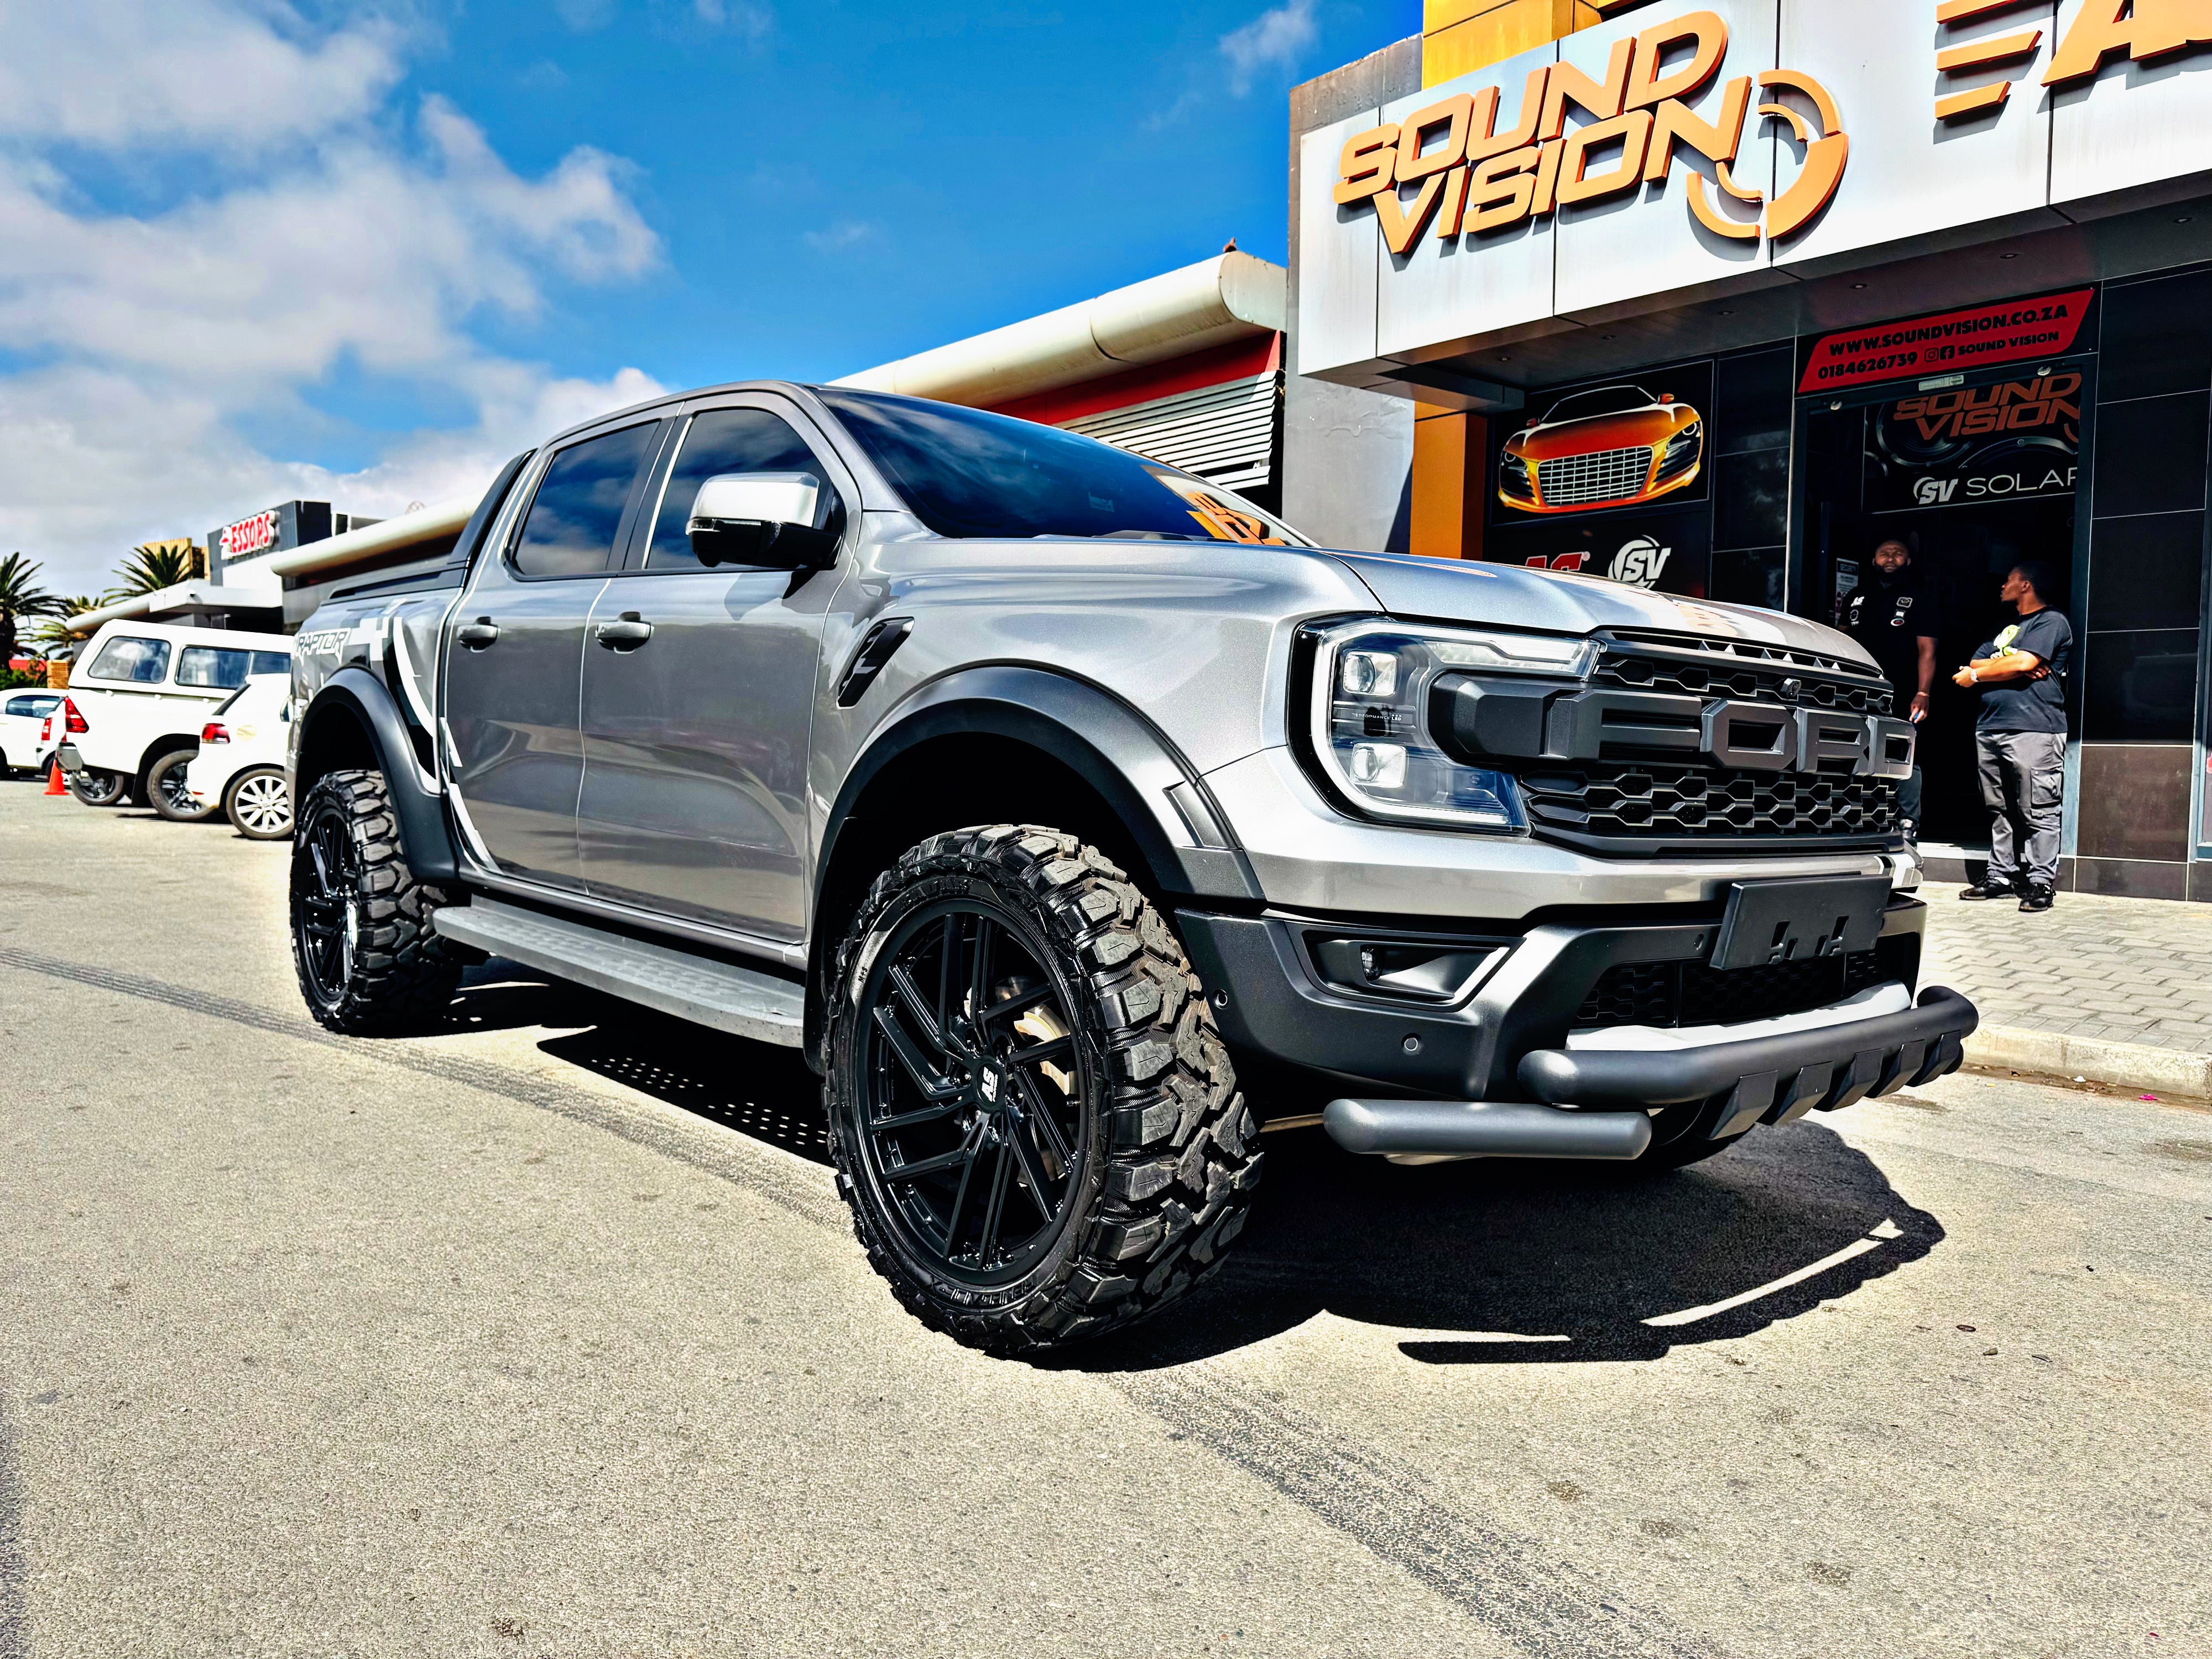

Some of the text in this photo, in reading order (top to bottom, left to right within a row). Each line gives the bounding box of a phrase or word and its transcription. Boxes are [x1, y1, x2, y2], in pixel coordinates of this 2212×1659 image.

[1333, 11, 1728, 205] SOUND
[1373, 76, 1751, 254] VISION
[1829, 305, 2068, 356] WWW.SOUNDVISION.CO.ZA
[1958, 331, 2059, 355] SOUND VISION
[1818, 351, 1918, 379] 0184626739
[1893, 373, 2082, 420] SOUND
[1918, 478, 1959, 504] SV
[1621, 547, 1672, 582] SV
[295, 628, 351, 666] RAPTOR
[1550, 690, 1916, 779] FORD
[858, 966, 868, 983] M+S
